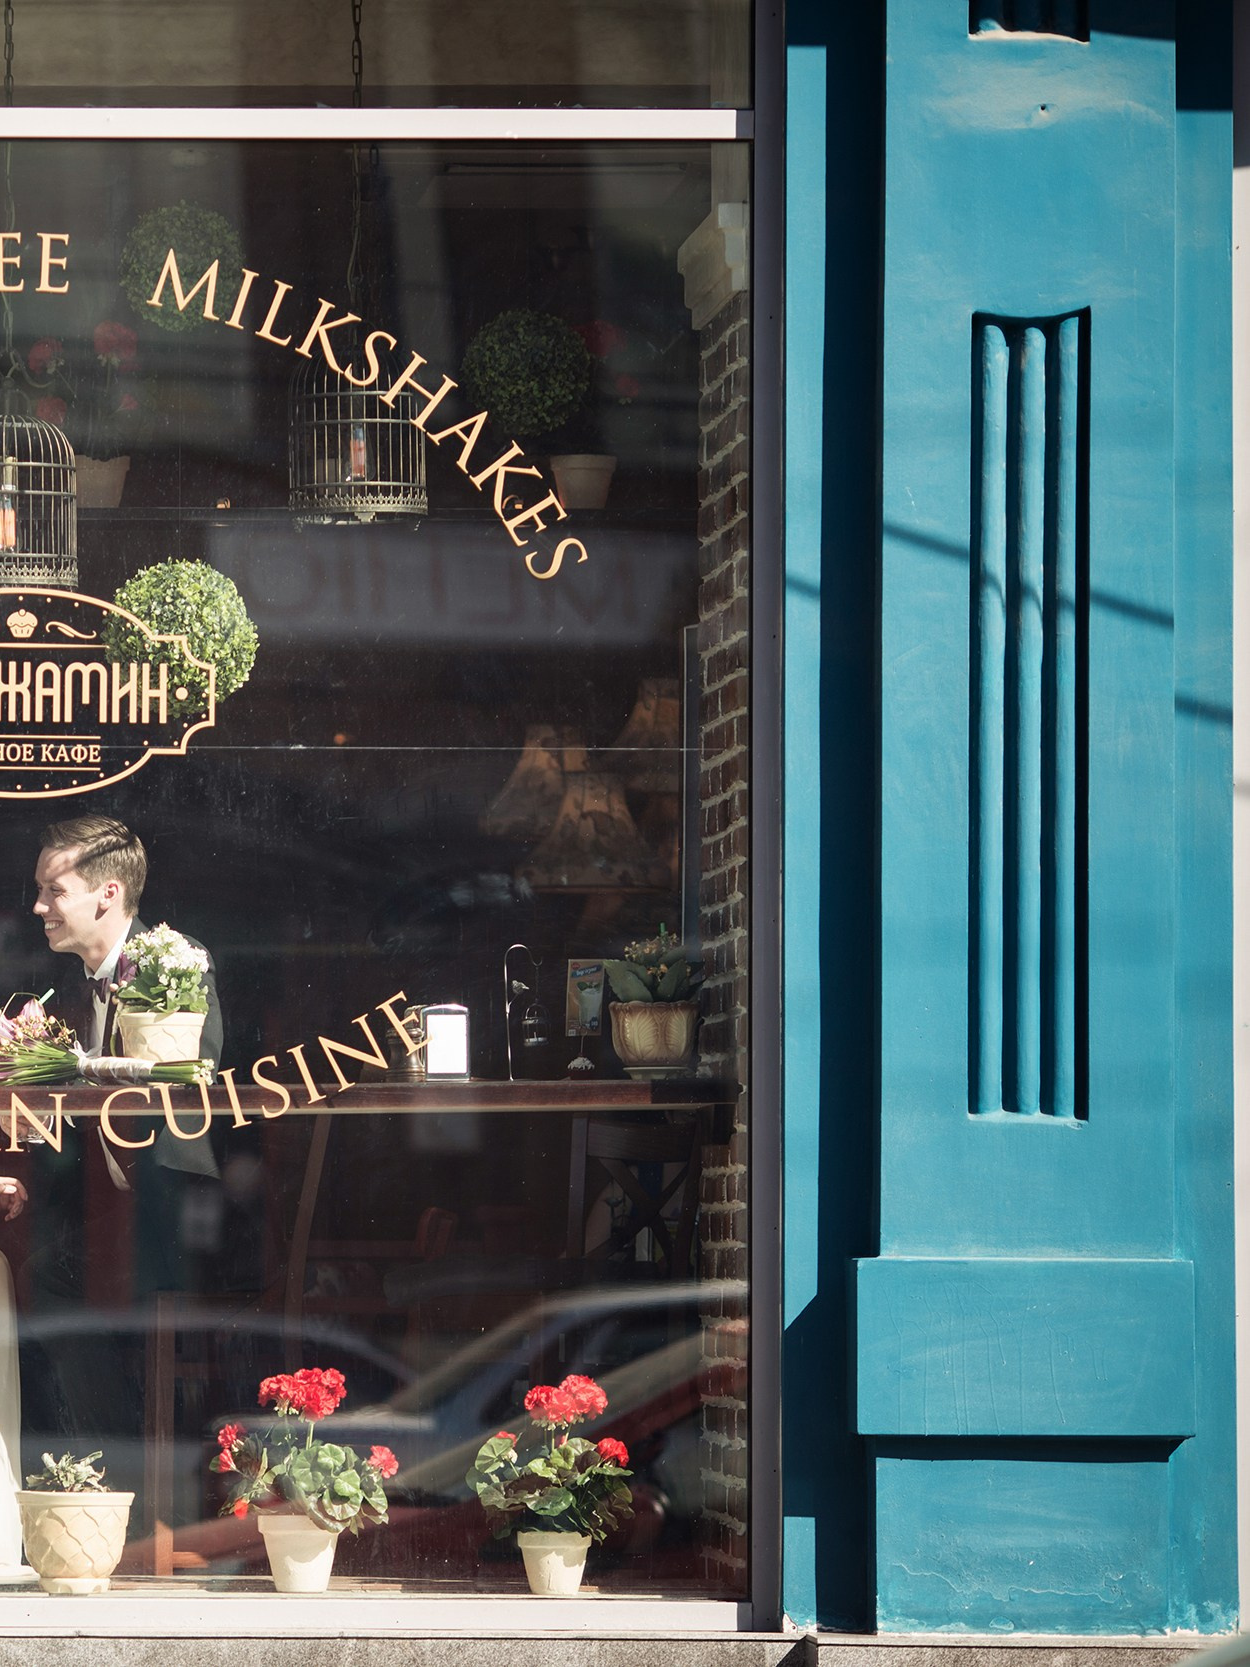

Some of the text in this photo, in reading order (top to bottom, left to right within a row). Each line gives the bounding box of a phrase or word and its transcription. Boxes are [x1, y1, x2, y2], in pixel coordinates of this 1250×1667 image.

[146, 248, 589, 580] MILKSHAKES
[40, 743, 102, 764] КАФЕ
[100, 989, 435, 1149] CUISINE
